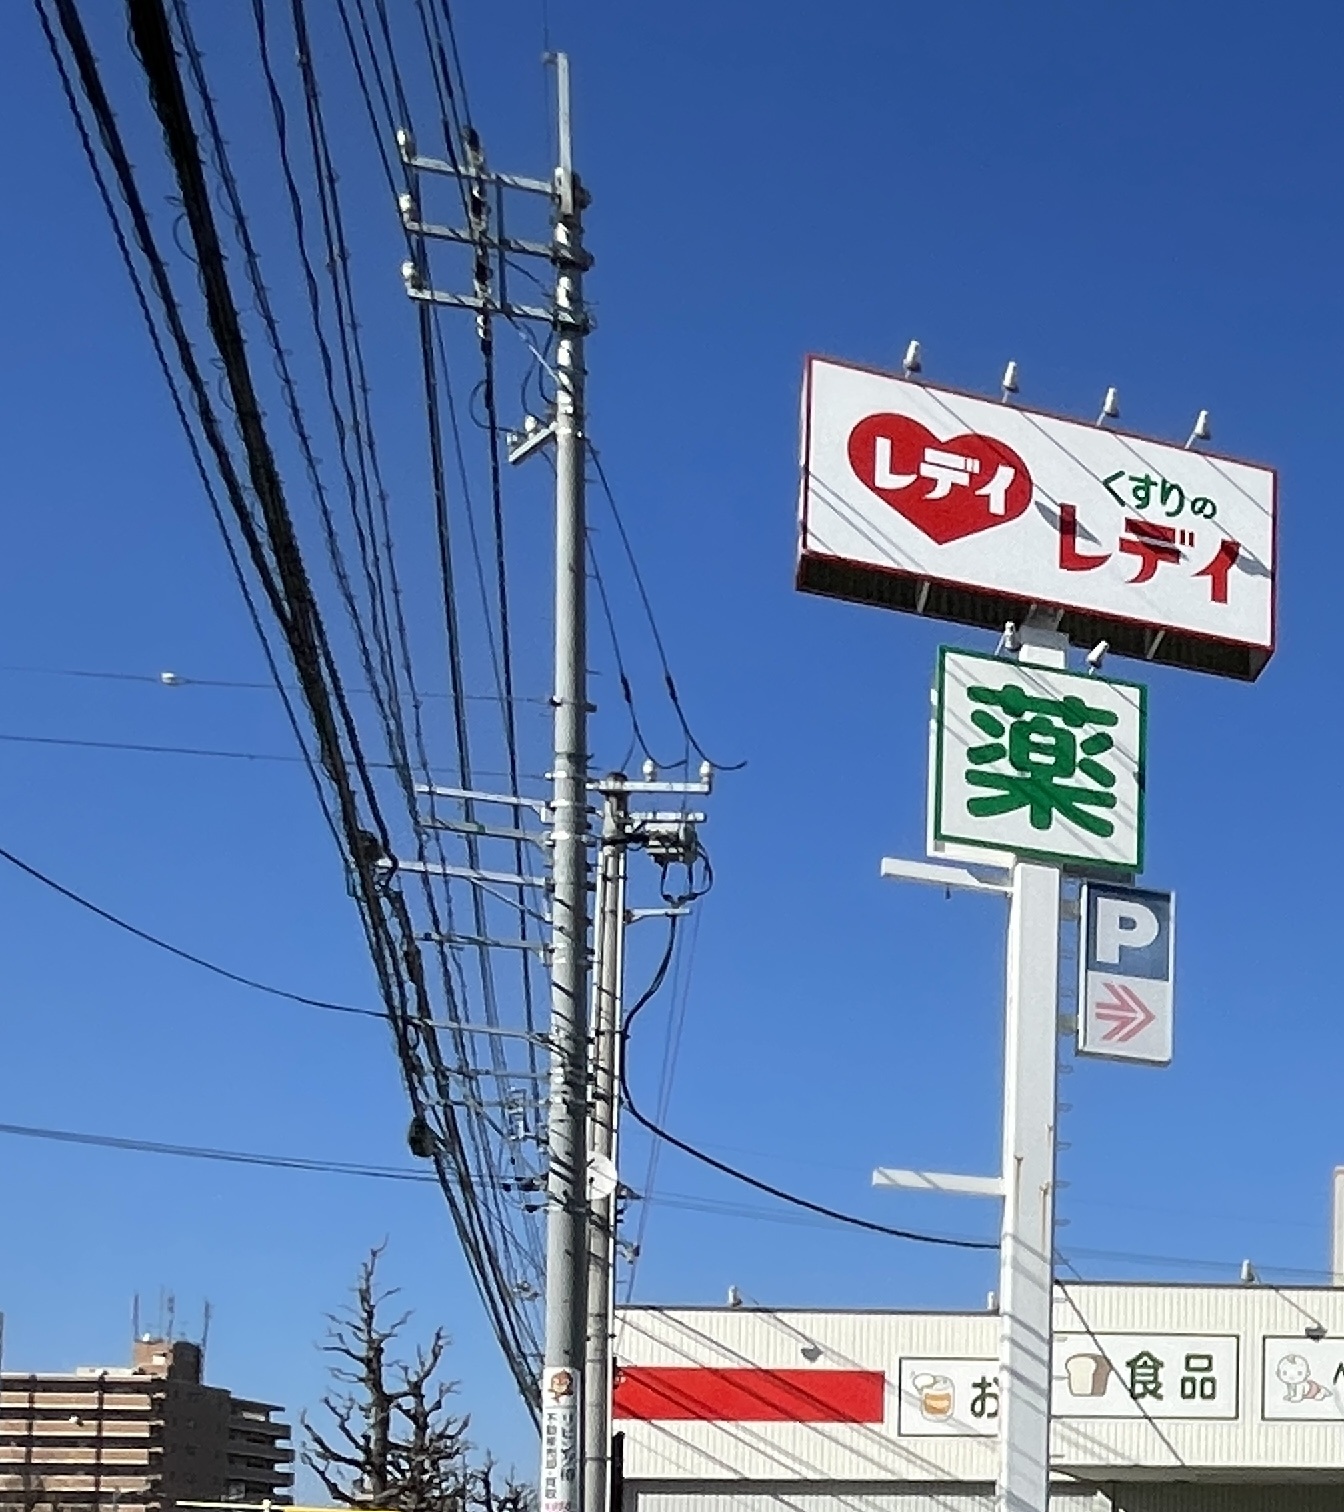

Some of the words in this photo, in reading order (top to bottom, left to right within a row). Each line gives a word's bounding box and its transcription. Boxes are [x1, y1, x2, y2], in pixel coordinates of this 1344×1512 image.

[1102, 470, 1218, 521] くすりの
[964, 684, 1119, 838] 薬
[1096, 896, 1160, 964] P
[970, 1375, 999, 1418] お
[1125, 1351, 1217, 1400] 食品
